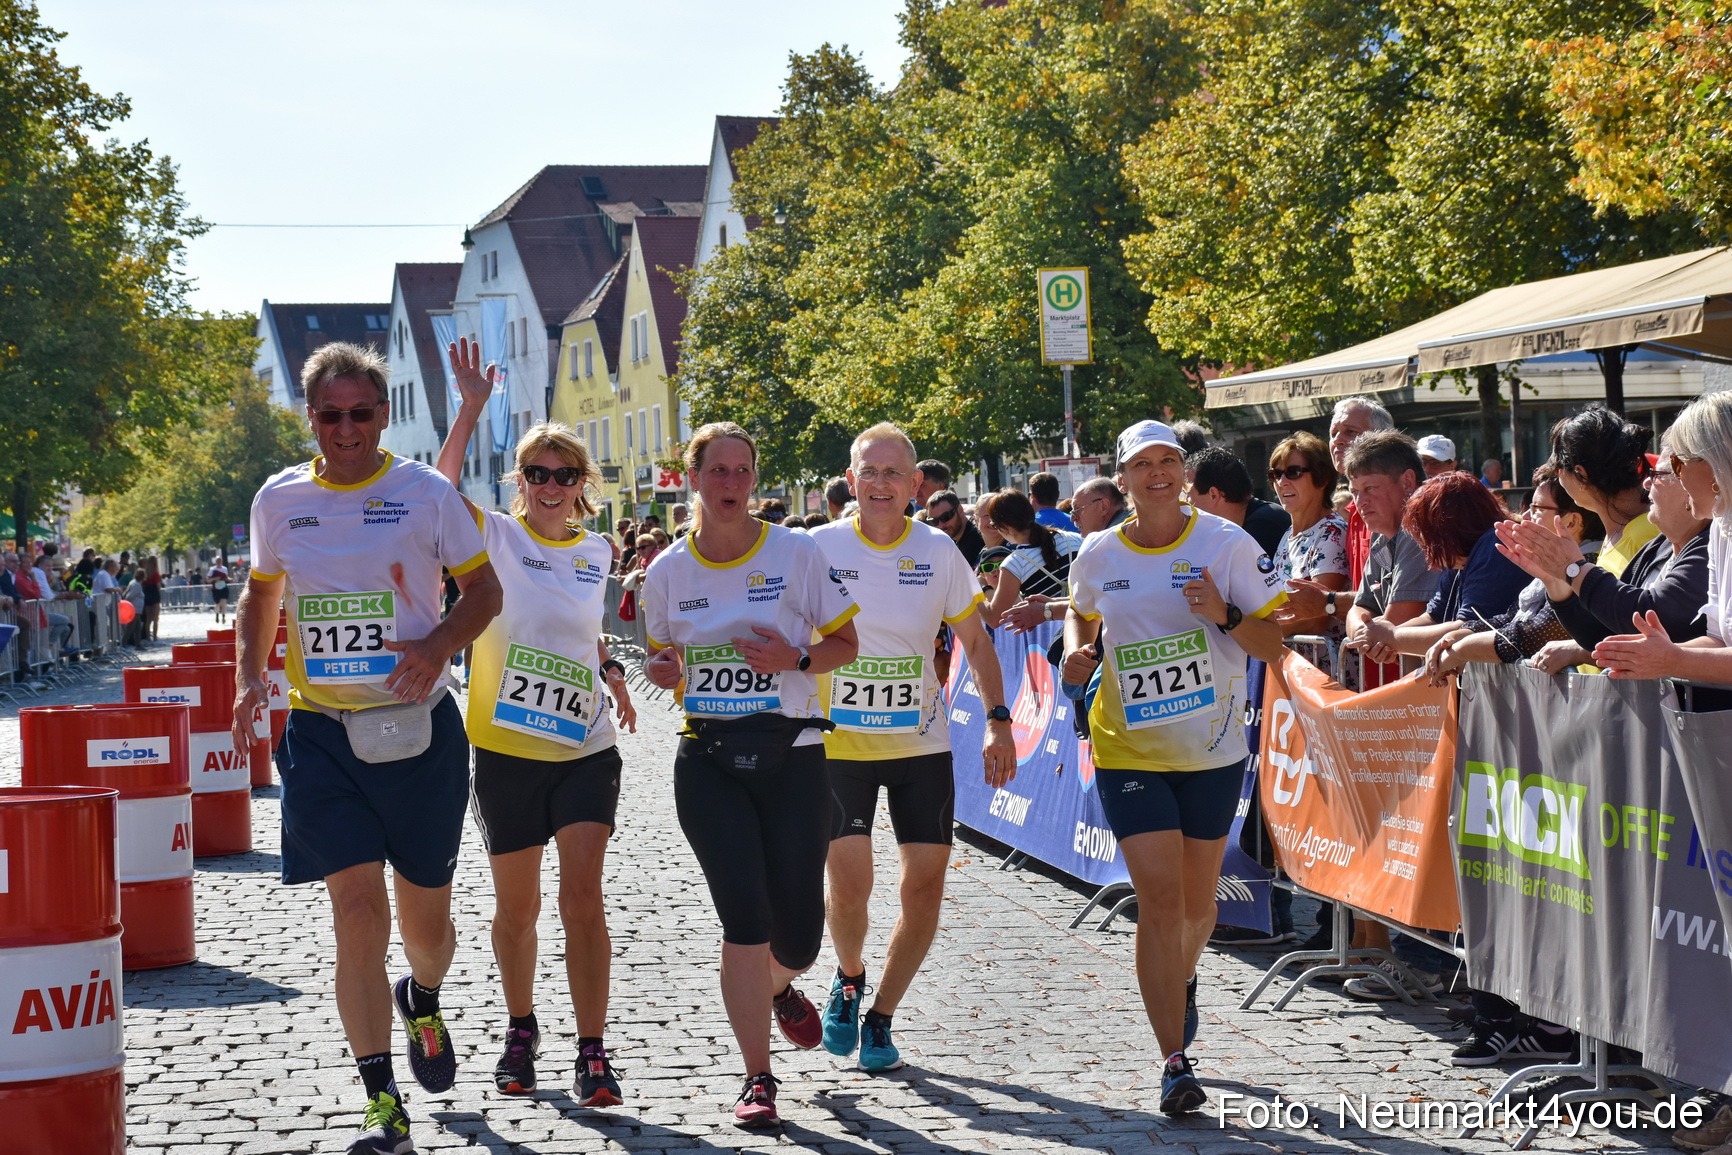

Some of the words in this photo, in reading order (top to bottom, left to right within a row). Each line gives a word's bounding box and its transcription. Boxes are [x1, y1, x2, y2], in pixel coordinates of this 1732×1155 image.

[289, 517, 319, 526] BOCK
[523, 556, 550, 568] BOCK
[573, 558, 588, 569] 20
[900, 559, 914, 570] 20
[1173, 562, 1190, 573] 20
[748, 574, 765, 587] 20
[837, 569, 859, 577] OCK
[748, 585, 787, 594] Neumarkter
[1104, 580, 1130, 590] BOCK
[303, 594, 387, 619] BOCK
[679, 598, 708, 610] BOCK
[748, 594, 780, 602] Stadtlauf
[308, 624, 384, 653] 2123
[692, 644, 745, 663] BO
[1122, 633, 1201, 667] BOCK
[324, 661, 370, 674] PETER
[513, 647, 589, 688] BOCK
[840, 659, 917, 677] BOCK
[696, 668, 774, 694] 2098
[1129, 661, 1202, 699] 2121
[509, 675, 582, 717] 2114
[842, 682, 913, 707] 2113
[697, 701, 768, 712] SUSANNE
[1140, 695, 1202, 718] CLAUDIA
[1334, 705, 1369, 720] Neumarkts
[1369, 705, 1408, 720] moderner
[1408, 704, 1440, 718] Partner
[525, 713, 558, 731] LISA
[860, 714, 892, 725] UWE
[1220, 708, 1232, 738] September
[1345, 726, 1355, 741] die
[1354, 727, 1395, 746] Konzeption
[1397, 725, 1414, 741] und
[101, 742, 159, 761] RÖDL
[134, 756, 159, 764] energie
[1368, 747, 1403, 766] Projekte
[989, 787, 1010, 818] GET
[1463, 770, 1583, 868] BOCK
[1270, 822, 1302, 852] reativ
[1297, 827, 1356, 868] Agentur
